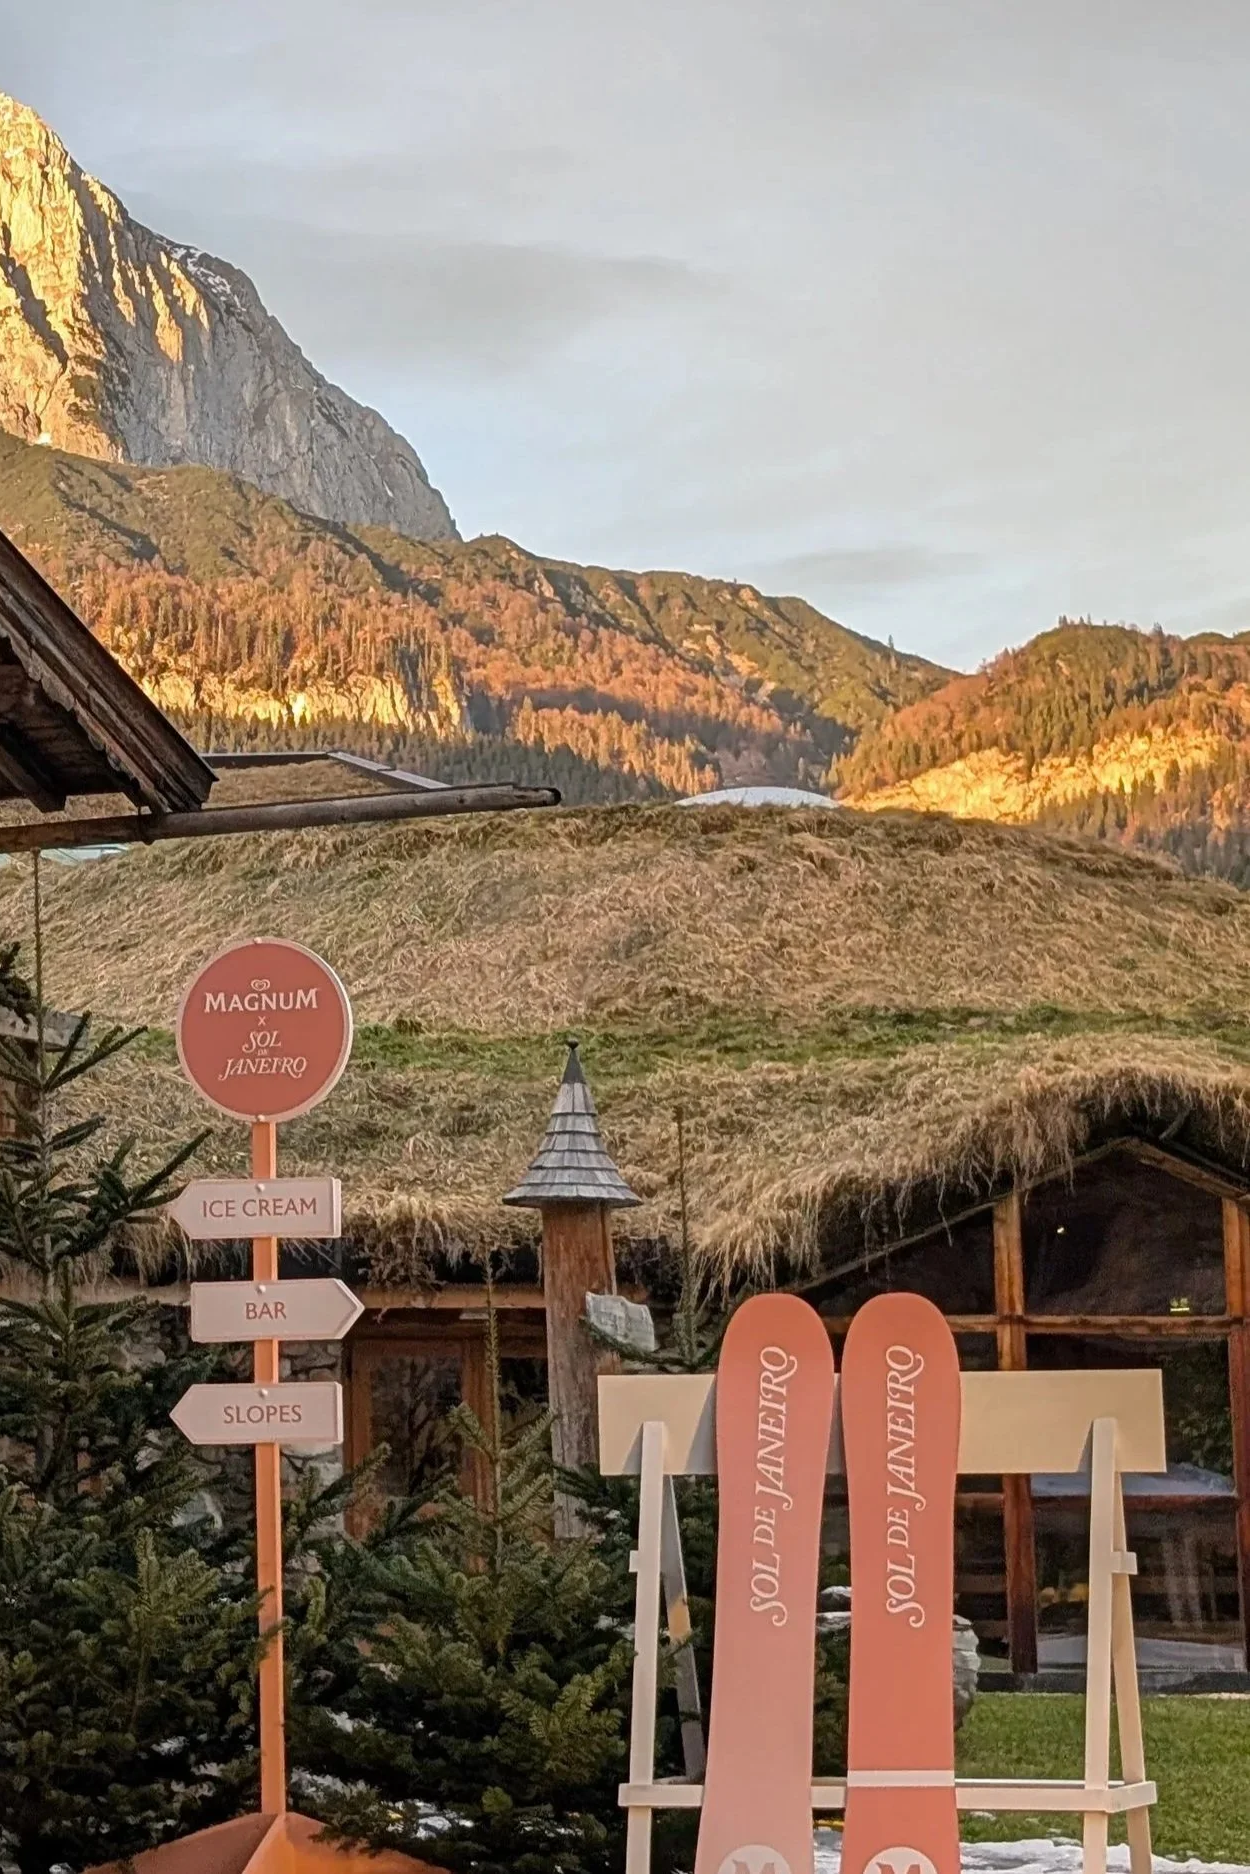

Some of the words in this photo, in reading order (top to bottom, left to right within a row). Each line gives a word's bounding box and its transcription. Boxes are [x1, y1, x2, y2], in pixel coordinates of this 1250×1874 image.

[204, 987, 320, 1013] MAGNUM
[242, 1030, 282, 1053] SOL
[217, 1056, 308, 1081] JANEIRO
[203, 1200, 235, 1217] ICE
[242, 1198, 317, 1216] CREAM
[245, 1302, 287, 1320] BAR
[223, 1405, 303, 1424] SLOPES
[755, 1346, 798, 1511] JANEIRO
[885, 1345, 926, 1511] JANEIRO
[753, 1506, 775, 1547] DE
[887, 1507, 909, 1548] DE
[751, 1552, 788, 1627] SOL
[886, 1553, 925, 1628] SOL
